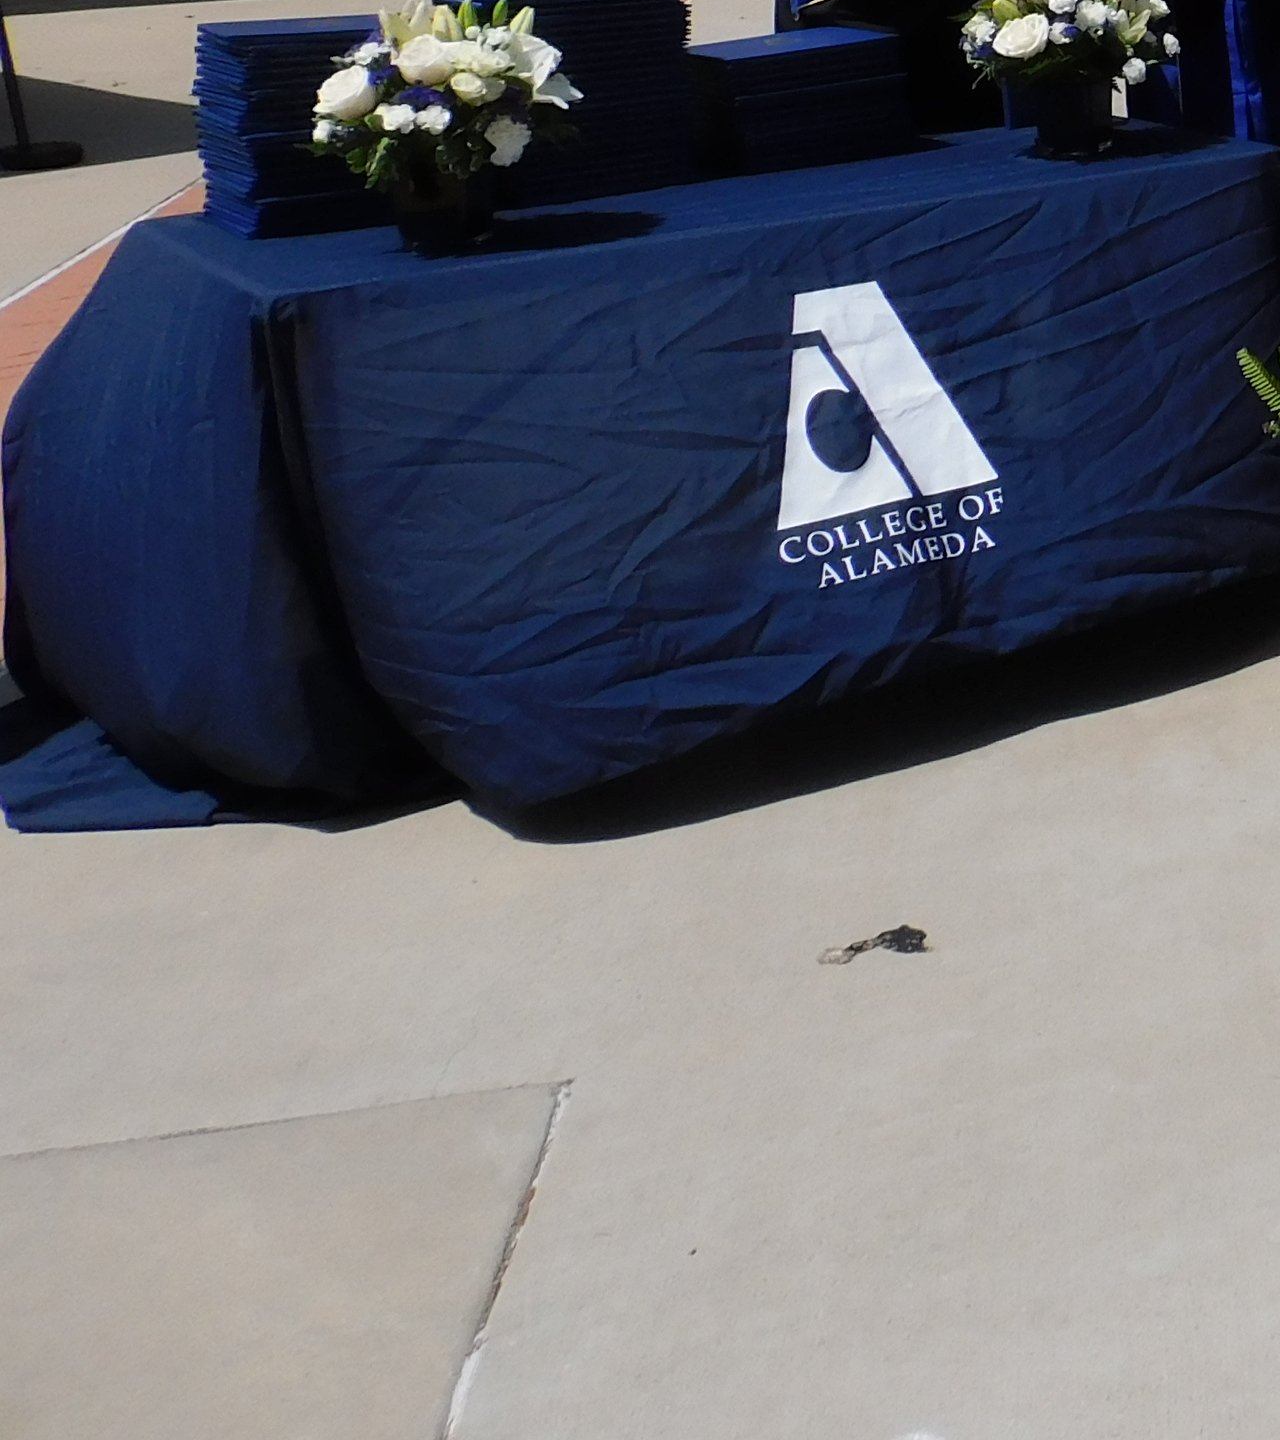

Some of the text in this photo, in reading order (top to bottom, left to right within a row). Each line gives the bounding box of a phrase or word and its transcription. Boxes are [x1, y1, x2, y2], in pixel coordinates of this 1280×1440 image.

[778, 487, 1004, 564] COLLEGE OF
[818, 526, 997, 589] ALAMEDA
